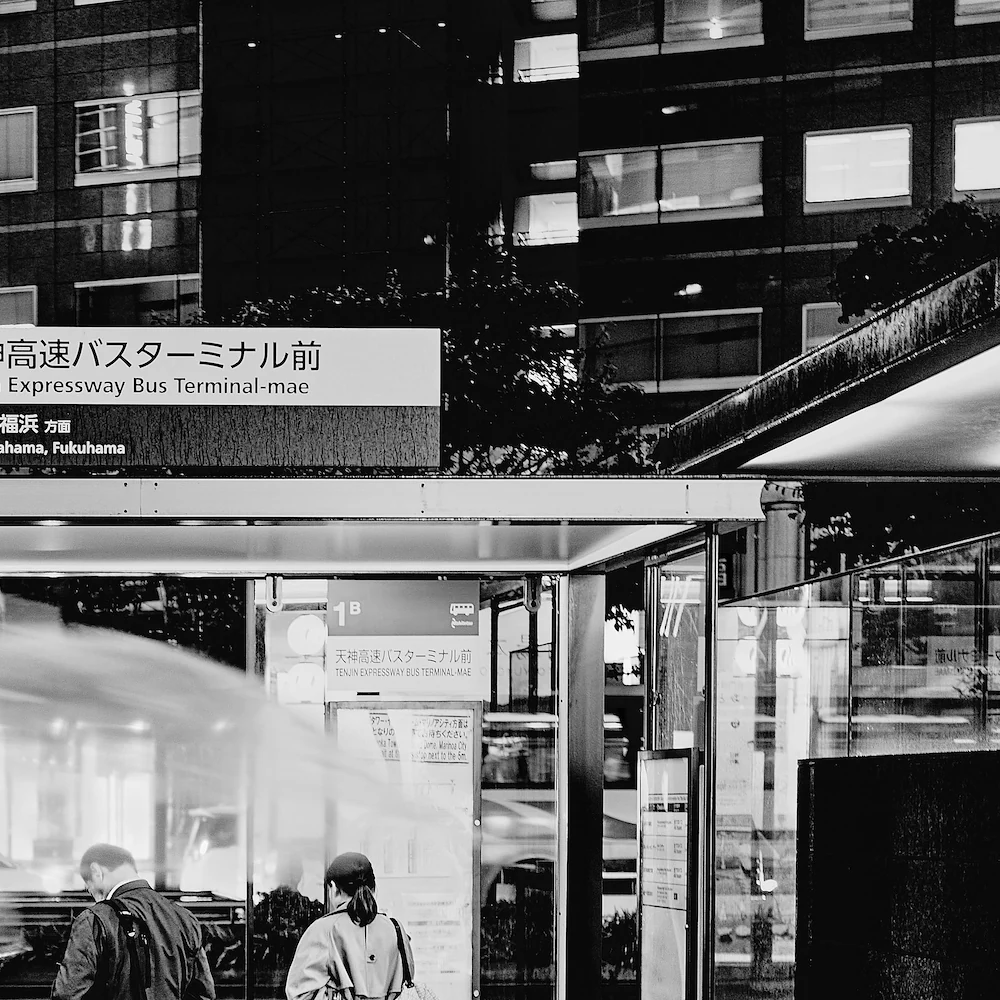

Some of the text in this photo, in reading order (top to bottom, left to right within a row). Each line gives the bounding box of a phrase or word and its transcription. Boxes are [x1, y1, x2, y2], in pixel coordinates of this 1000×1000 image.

[8, 376, 125, 398] Expressway
[134, 377, 167, 394] Bus
[174, 377, 310, 395] Terminal-mae
[0, 413, 39, 434] 福浜
[44, 419, 71, 434] 方面
[52, 440, 126, 455] Fukuhama
[333, 601, 361, 627] 1B
[335, 649, 472, 664] 天神高速バスターミナル前
[335, 668, 472, 677] TENJIN EXPRESSWAY BUS TERMINAL-MAE
